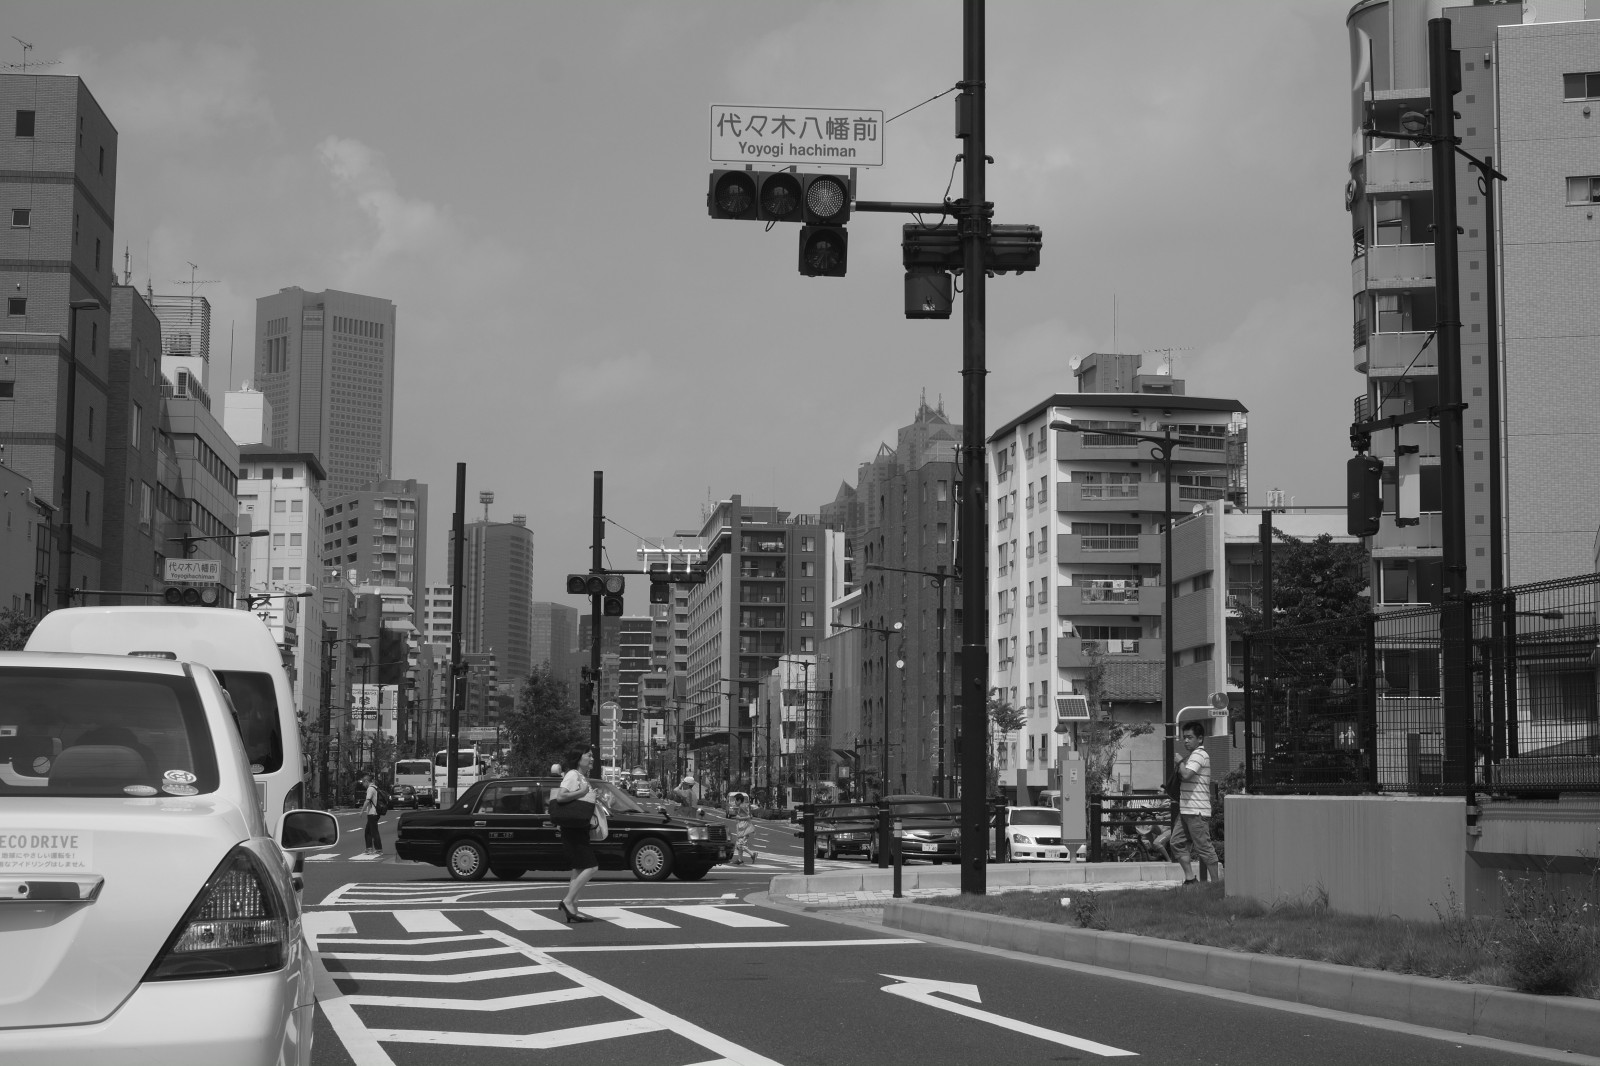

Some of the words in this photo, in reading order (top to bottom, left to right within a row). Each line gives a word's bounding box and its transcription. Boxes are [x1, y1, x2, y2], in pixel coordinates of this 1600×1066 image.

[716, 112, 878, 142] 代々木八幡前
[738, 141, 784, 157] Yoyogi
[789, 143, 856, 158] hachiman
[168, 561, 218, 573] 代々木八幡前
[0, 834, 27, 848] ECO
[30, 835, 79, 849] DRIVE
